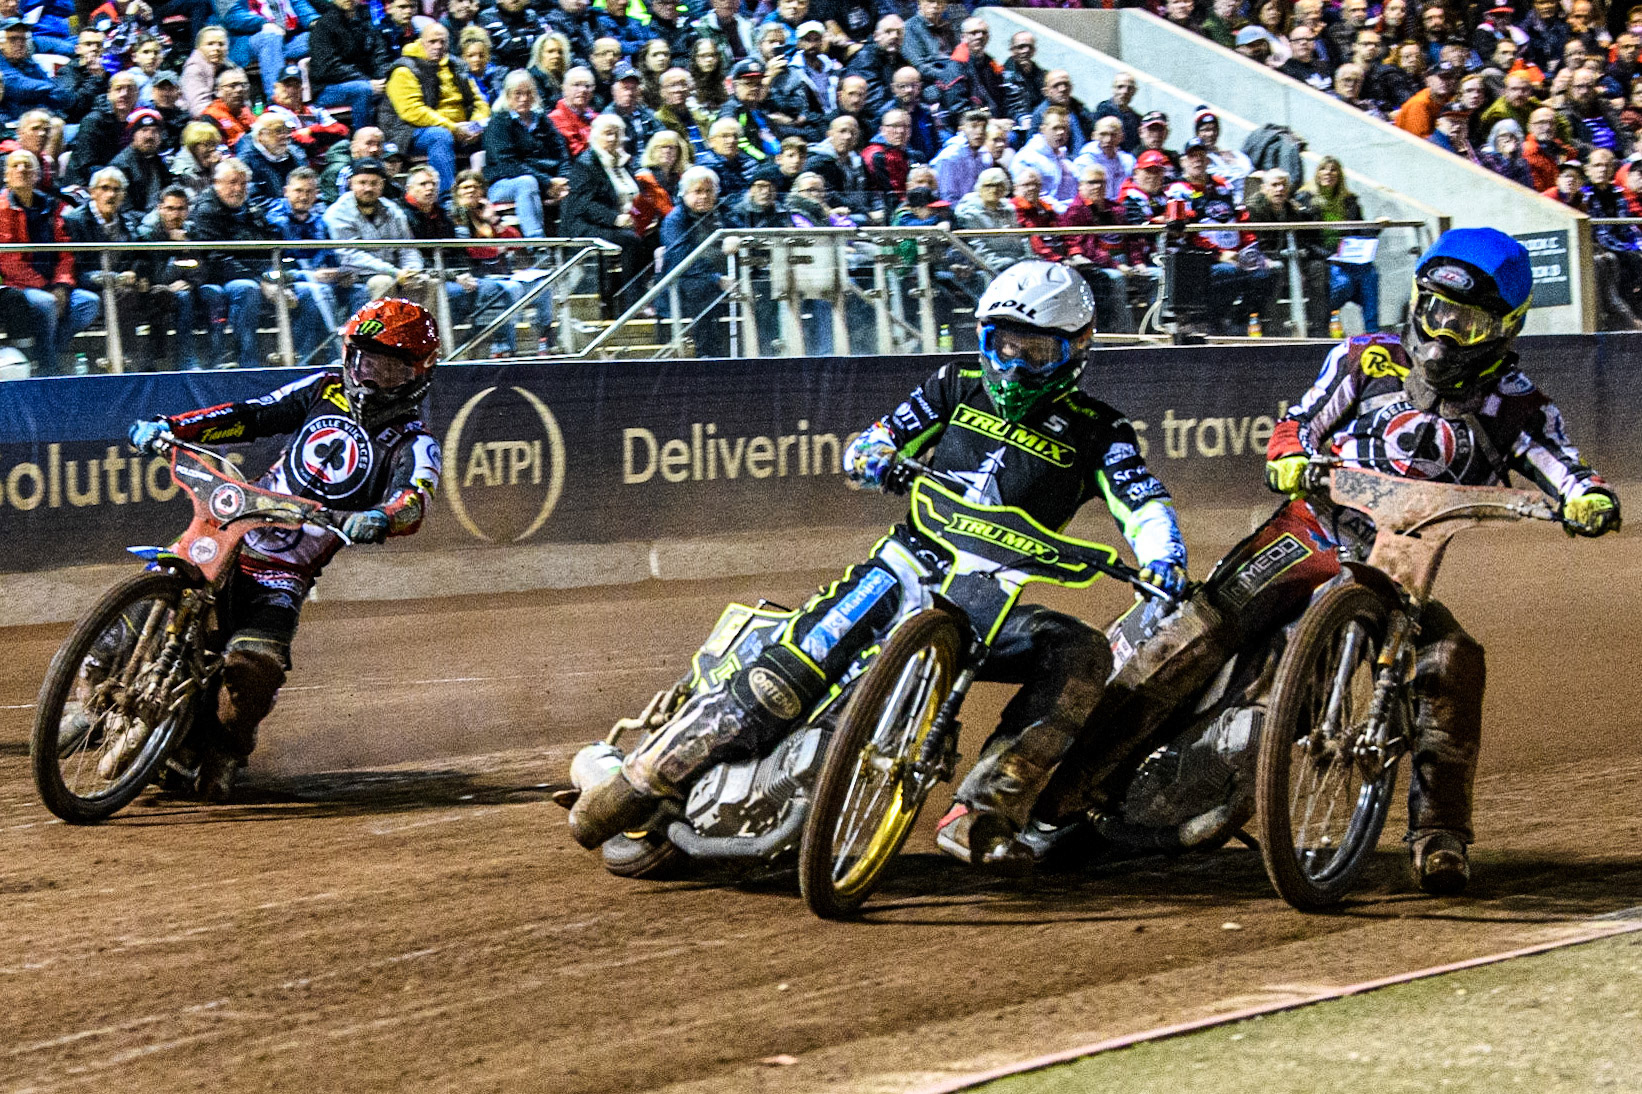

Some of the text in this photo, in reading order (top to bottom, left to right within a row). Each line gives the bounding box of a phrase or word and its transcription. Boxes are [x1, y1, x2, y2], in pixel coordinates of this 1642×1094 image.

[310, 420, 340, 432] BELLE
[358, 443, 369, 470] ACES
[959, 409, 1012, 436] TRU
[1010, 428, 1069, 461] MIX
[463, 439, 543, 488] ATPI
[958, 518, 1051, 556] TRU MIX
